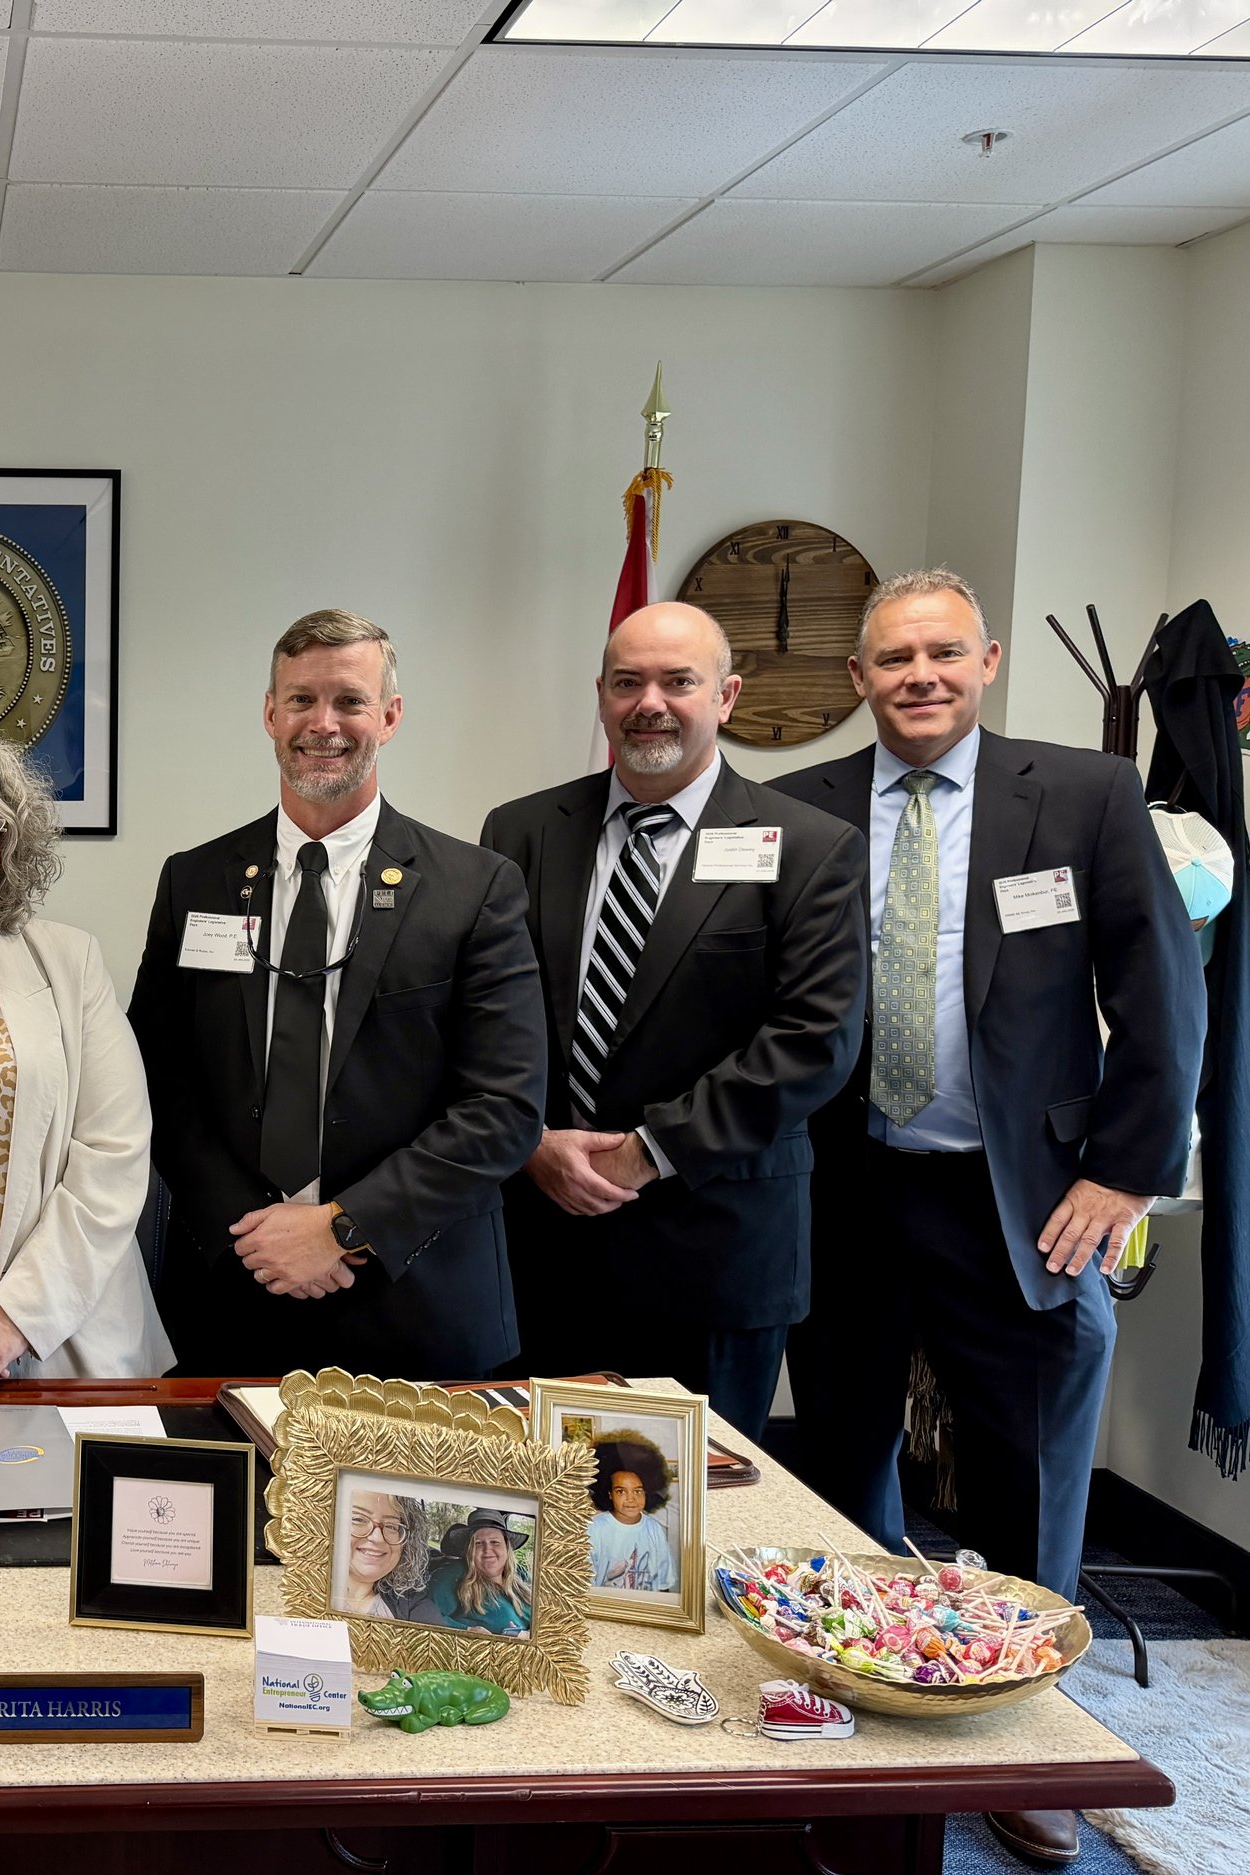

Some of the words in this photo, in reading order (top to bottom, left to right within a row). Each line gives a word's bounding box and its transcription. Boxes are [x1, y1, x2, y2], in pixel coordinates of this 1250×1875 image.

[776, 526, 789, 539] XII
[730, 541, 740, 556] XI
[694, 577, 703, 592] X
[262, 1676, 300, 1689] National
[262, 1687, 306, 1698] Entrepreneur
[324, 1691, 347, 1699] Center
[47, 1700, 122, 1717] HARRIS
[279, 1702, 330, 1712] NationalEC.org
